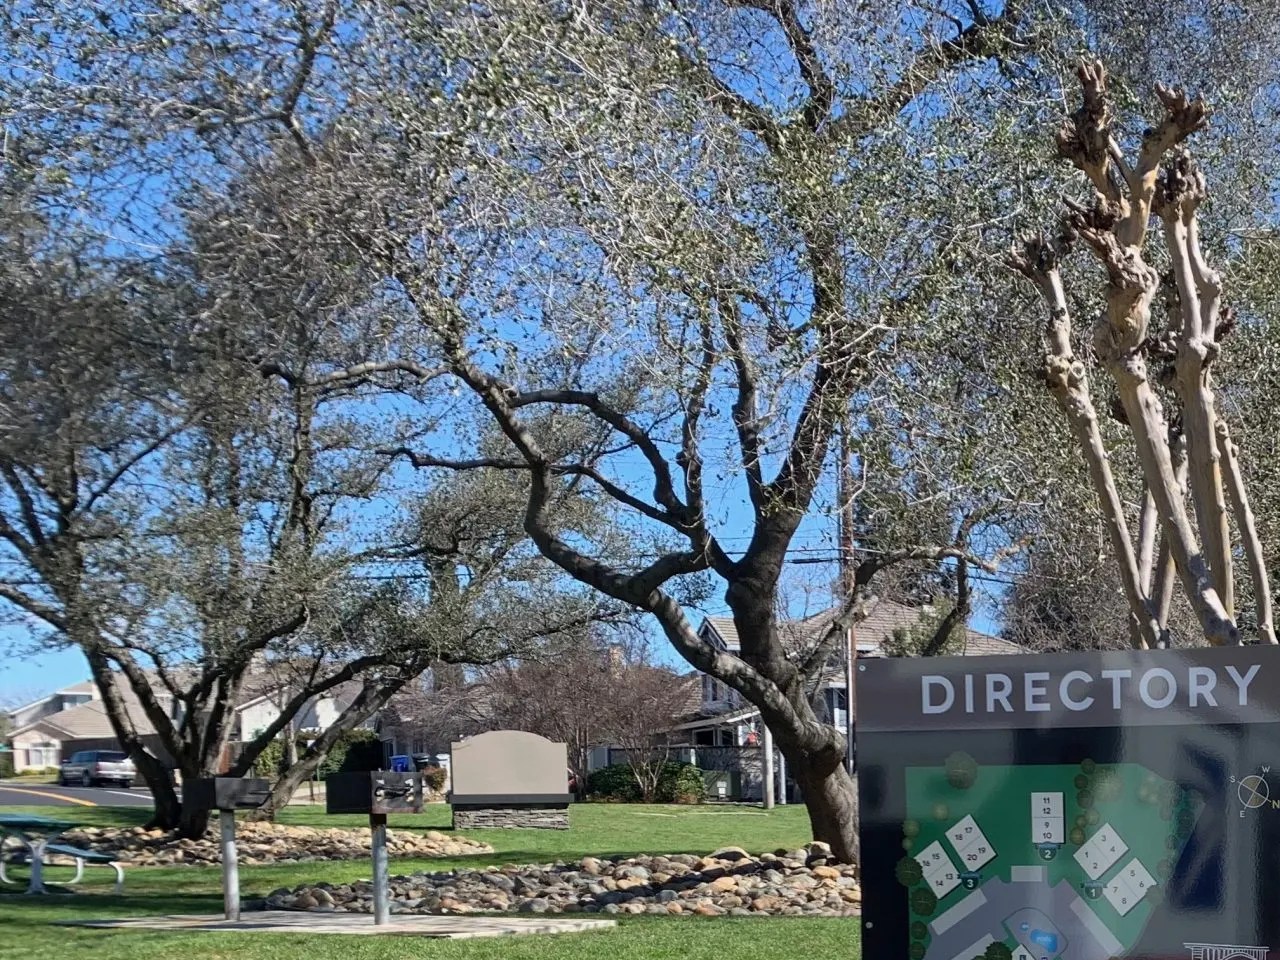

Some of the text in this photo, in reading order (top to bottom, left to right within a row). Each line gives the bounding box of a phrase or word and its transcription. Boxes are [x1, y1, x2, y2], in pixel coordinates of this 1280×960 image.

[921, 664, 1261, 714] DIRECTORY
[1261, 765, 1271, 773] W
[1230, 775, 1236, 783] S
[1272, 799, 1280, 809] N
[1043, 807, 1051, 815] 12
[1239, 810, 1246, 818] E
[1044, 821, 1050, 829] 9
[965, 826, 973, 834] 17
[1043, 832, 1052, 840] 10
[1044, 849, 1051, 859] 2
[1093, 862, 1098, 870] 2
[945, 873, 954, 881] 13
[966, 878, 974, 888] 3
[1139, 880, 1145, 888] 6
[1090, 888, 1096, 898] 1
[1112, 886, 1118, 894] 7
